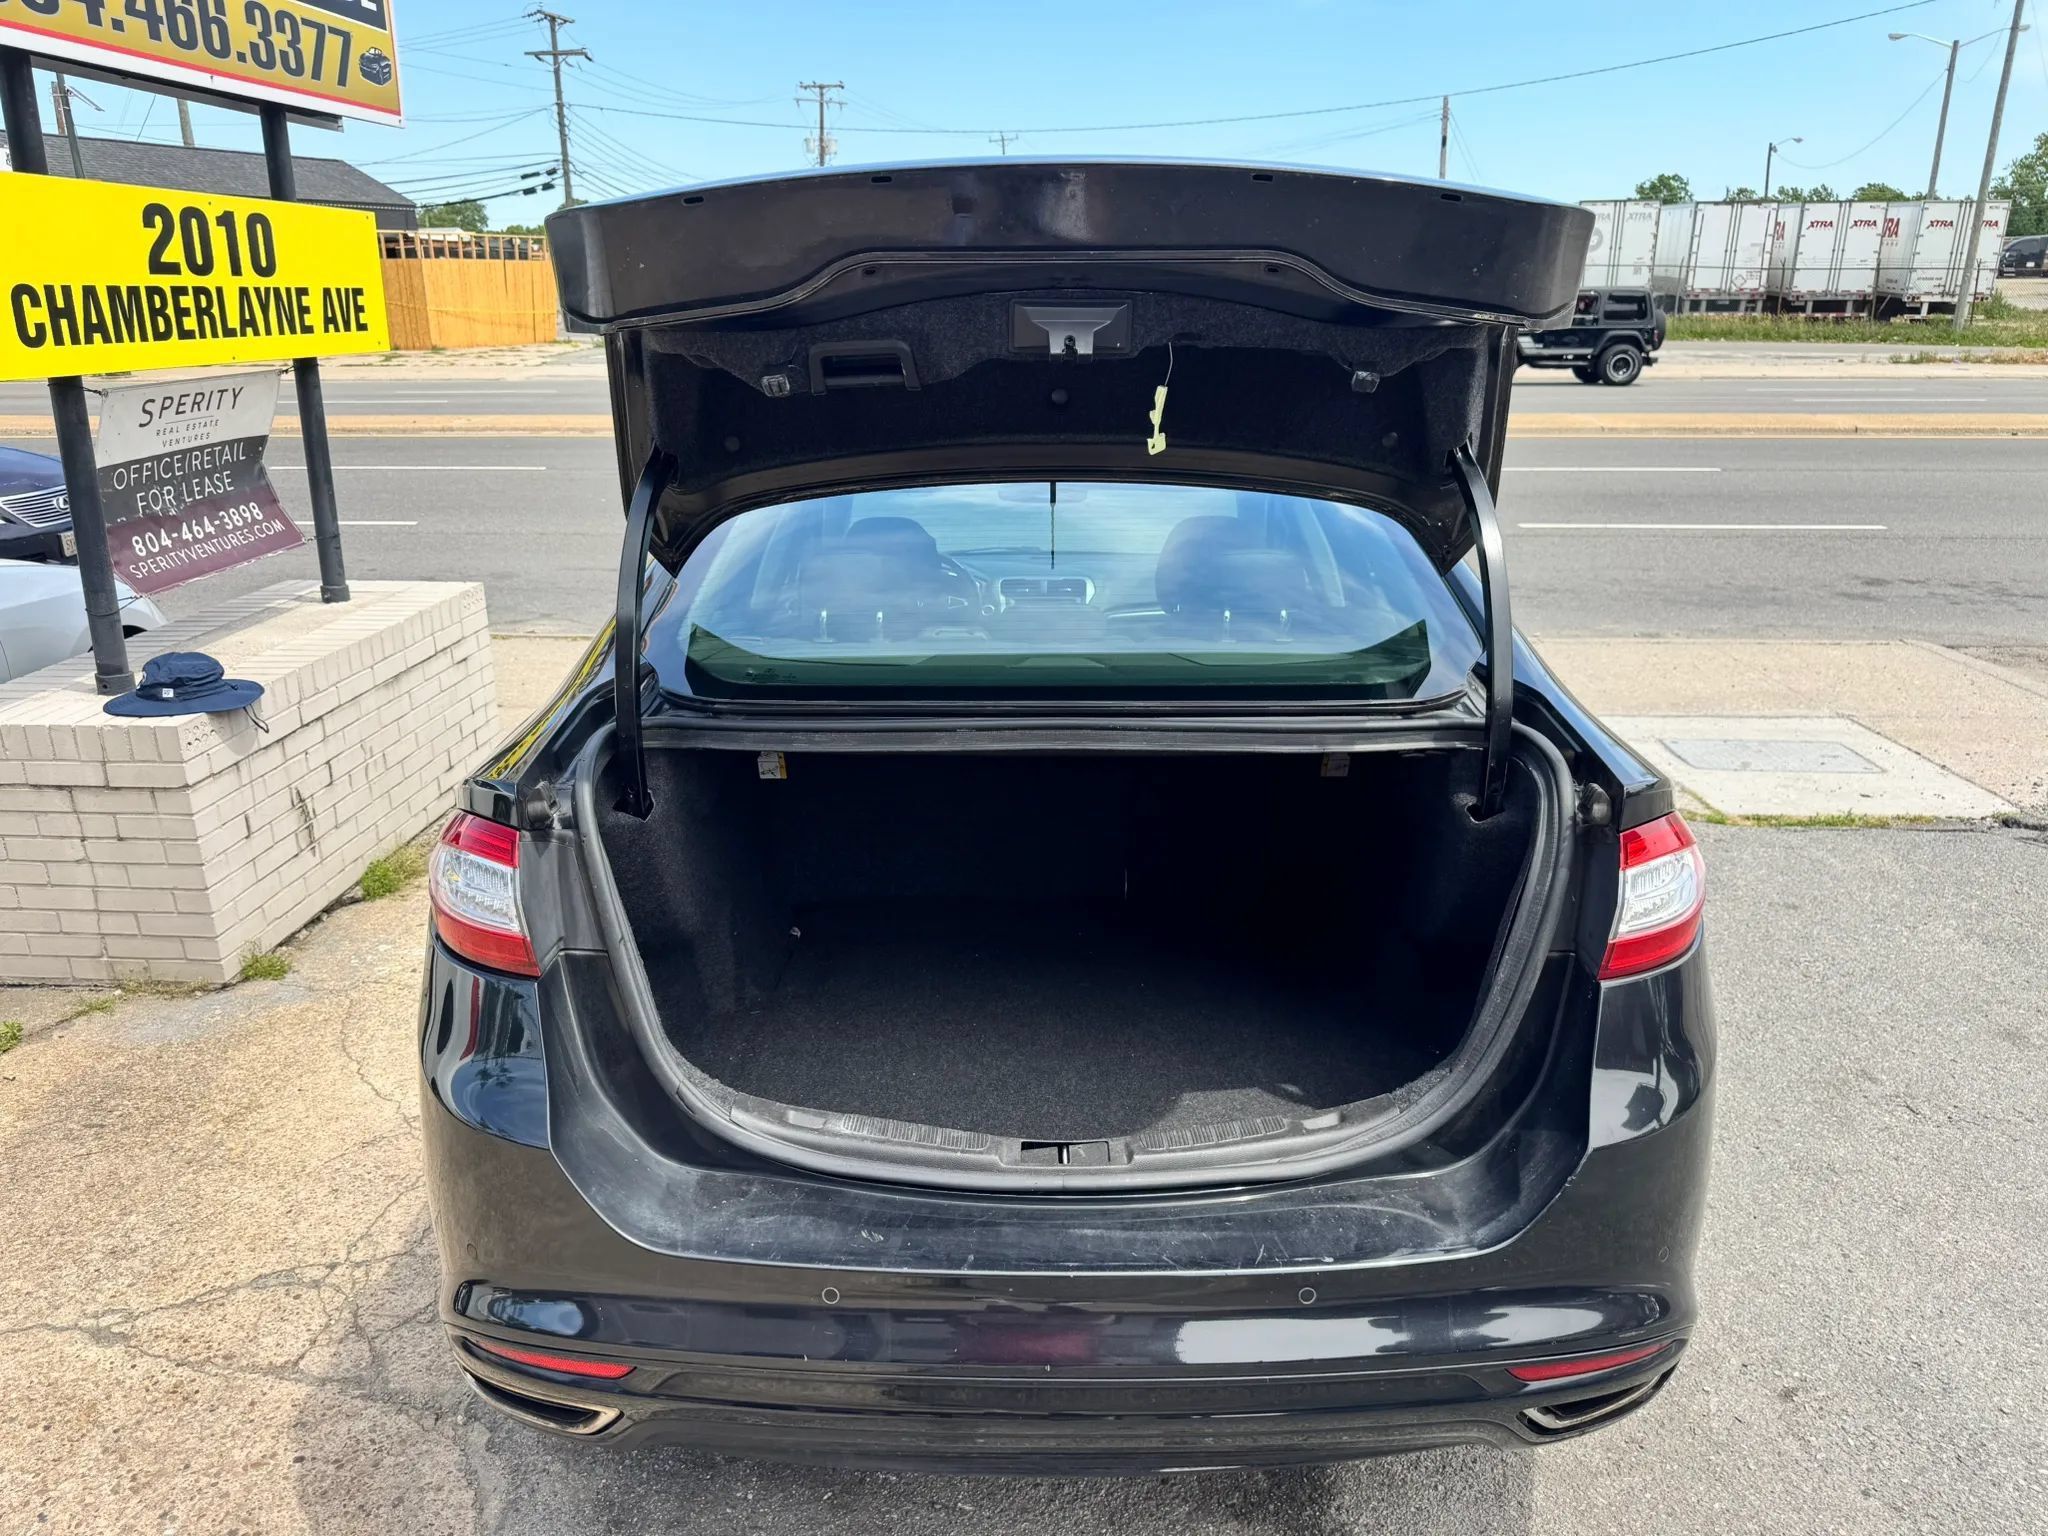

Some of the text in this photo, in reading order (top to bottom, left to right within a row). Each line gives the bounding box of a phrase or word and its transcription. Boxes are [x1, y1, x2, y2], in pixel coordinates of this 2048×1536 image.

[0, 0, 352, 87] .466.3377
[142, 203, 277, 278] 2010
[1806, 219, 1833, 230] XTRA
[1850, 219, 1877, 229] XTRA
[1926, 219, 1954, 229] XTRA
[11, 283, 368, 348] CHAMBERLAYNE AVE
[138, 386, 244, 428] SPERITY
[156, 419, 220, 437] REAL ESTATE
[162, 432, 211, 448] VENTURES
[113, 442, 247, 490] OFFICE/RETAIL
[136, 471, 235, 515] FOR LEASE
[129, 519, 286, 579] SPERITYVENTURES.COM
[132, 502, 264, 557] 804-464-3898
